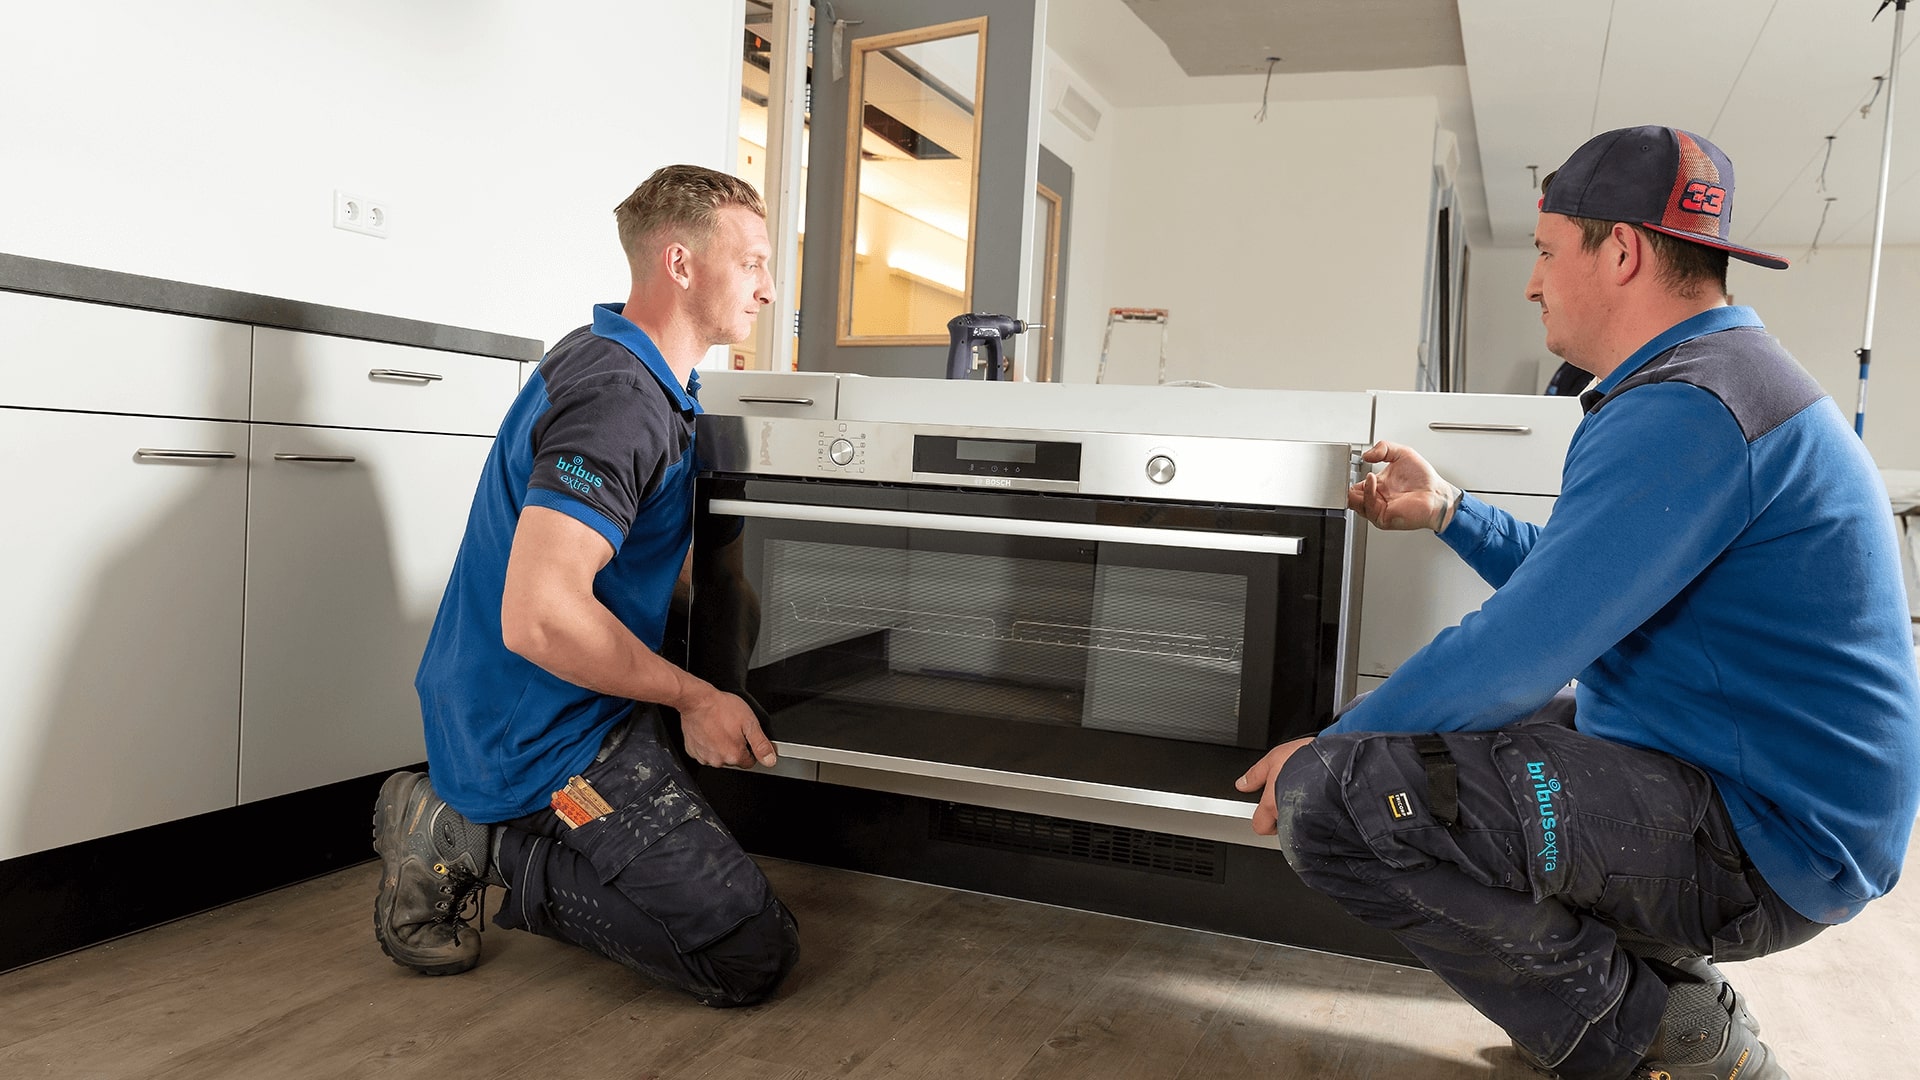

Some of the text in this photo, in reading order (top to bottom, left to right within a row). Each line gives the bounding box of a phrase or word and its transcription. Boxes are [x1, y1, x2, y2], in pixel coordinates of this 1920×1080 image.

[1681, 180, 1726, 216] 33
[556, 455, 604, 488] bribus
[560, 474, 591, 494] extra
[985, 478, 1011, 487] BOSCH
